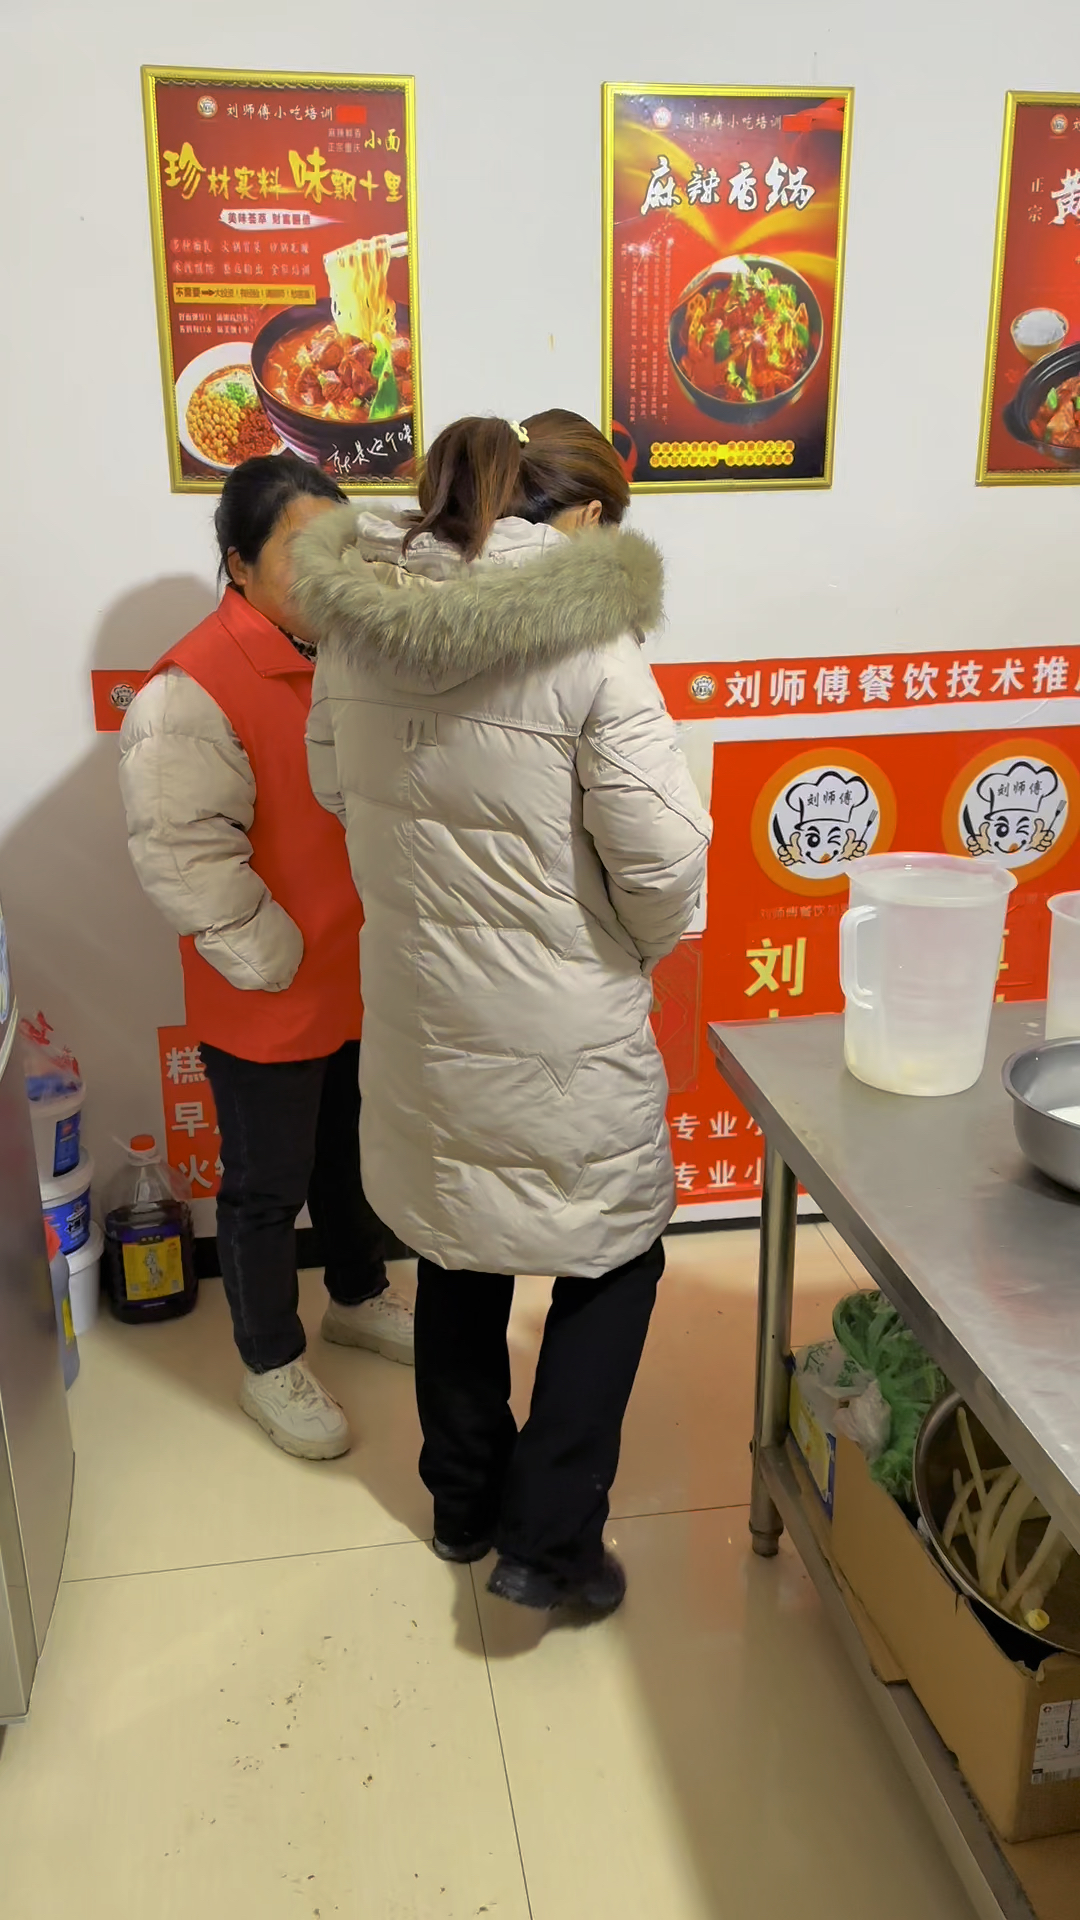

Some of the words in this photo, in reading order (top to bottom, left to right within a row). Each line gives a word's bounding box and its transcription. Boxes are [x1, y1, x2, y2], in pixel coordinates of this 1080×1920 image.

[226, 103, 333, 121] 刘师傅小吃培训
[684, 111, 782, 130] 刘师傅小吃培训
[364, 128, 400, 152] 小面
[641, 155, 816, 216] 麻辣香锅
[724, 655, 1080, 708] 刘师傅餐饮技术推
[807, 789, 853, 808] 刘师傅
[997, 780, 1043, 797] 刘师傅
[171, 1101, 221, 1138] 早
[178, 1153, 225, 1189] 火
